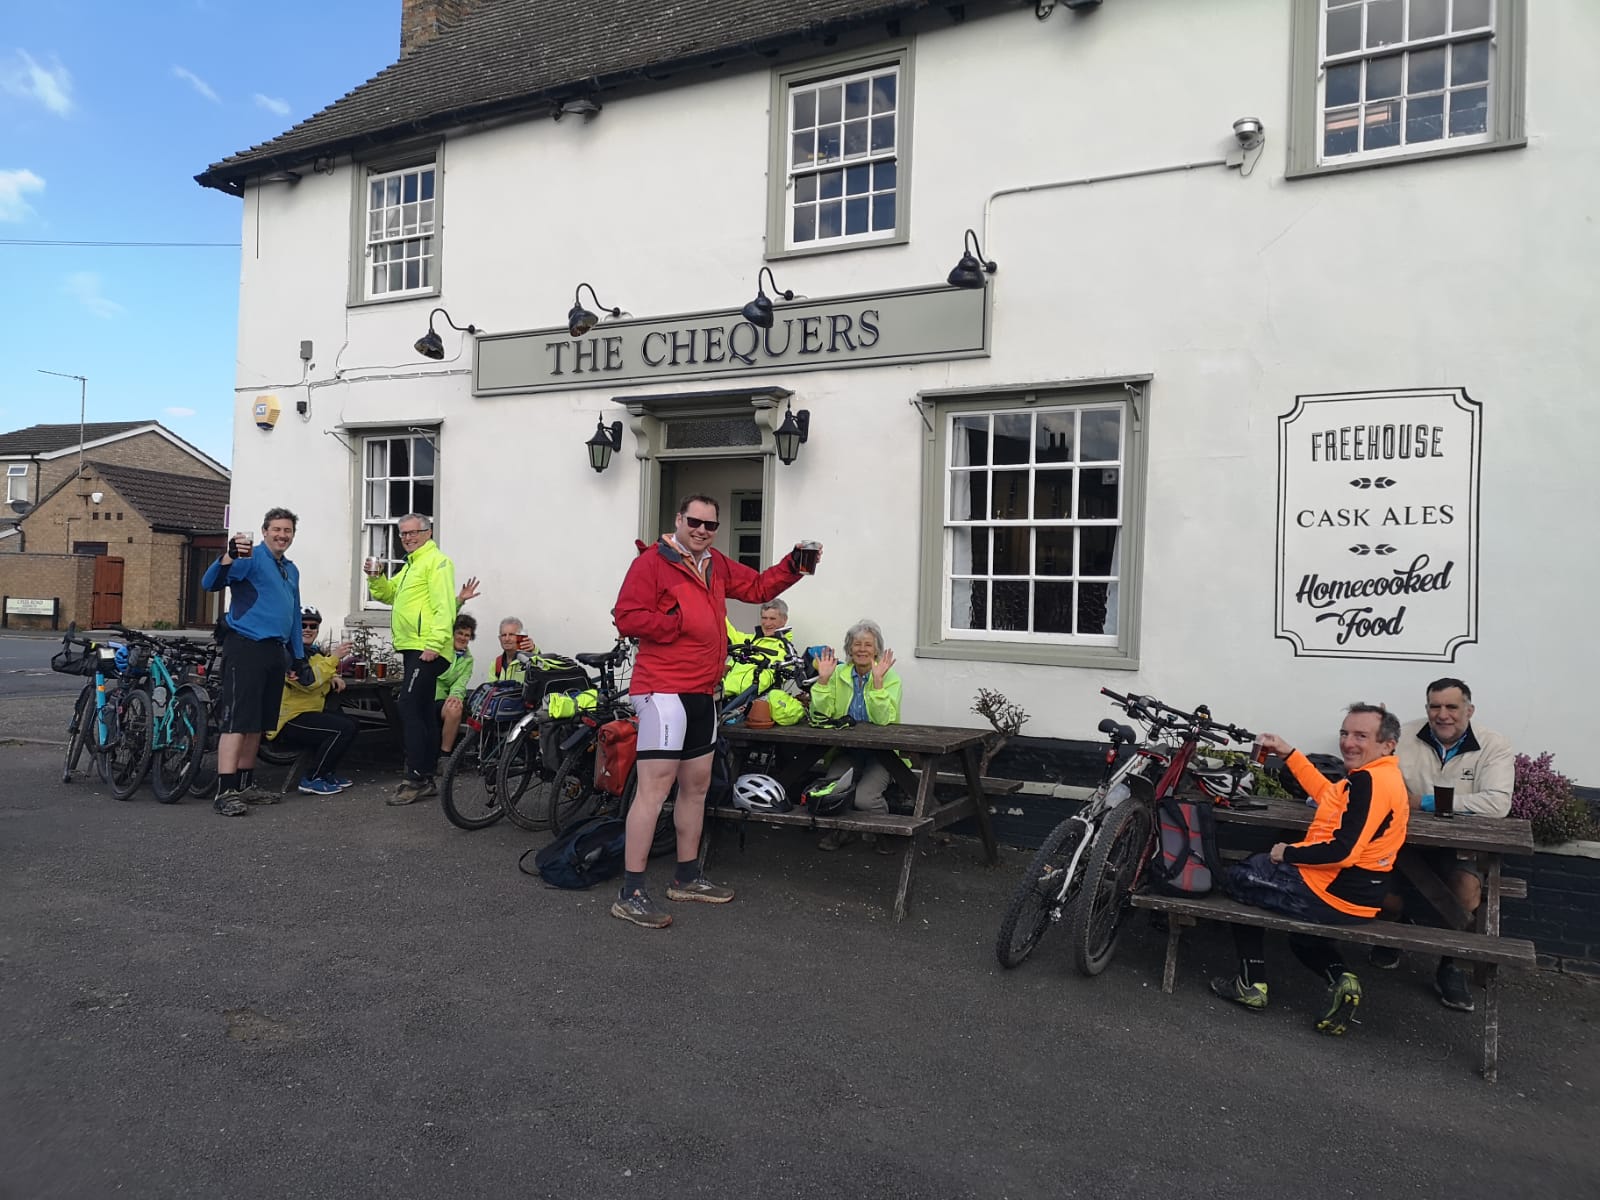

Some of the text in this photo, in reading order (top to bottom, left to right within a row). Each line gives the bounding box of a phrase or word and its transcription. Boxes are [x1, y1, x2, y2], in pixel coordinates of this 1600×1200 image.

[545, 310, 879, 375] THE CHEQUERS
[1311, 424, 1444, 461] FREEHOUSE
[1296, 504, 1454, 528] CASK ALES
[1296, 554, 1454, 608] Homecooked
[1315, 605, 1406, 645] Food
